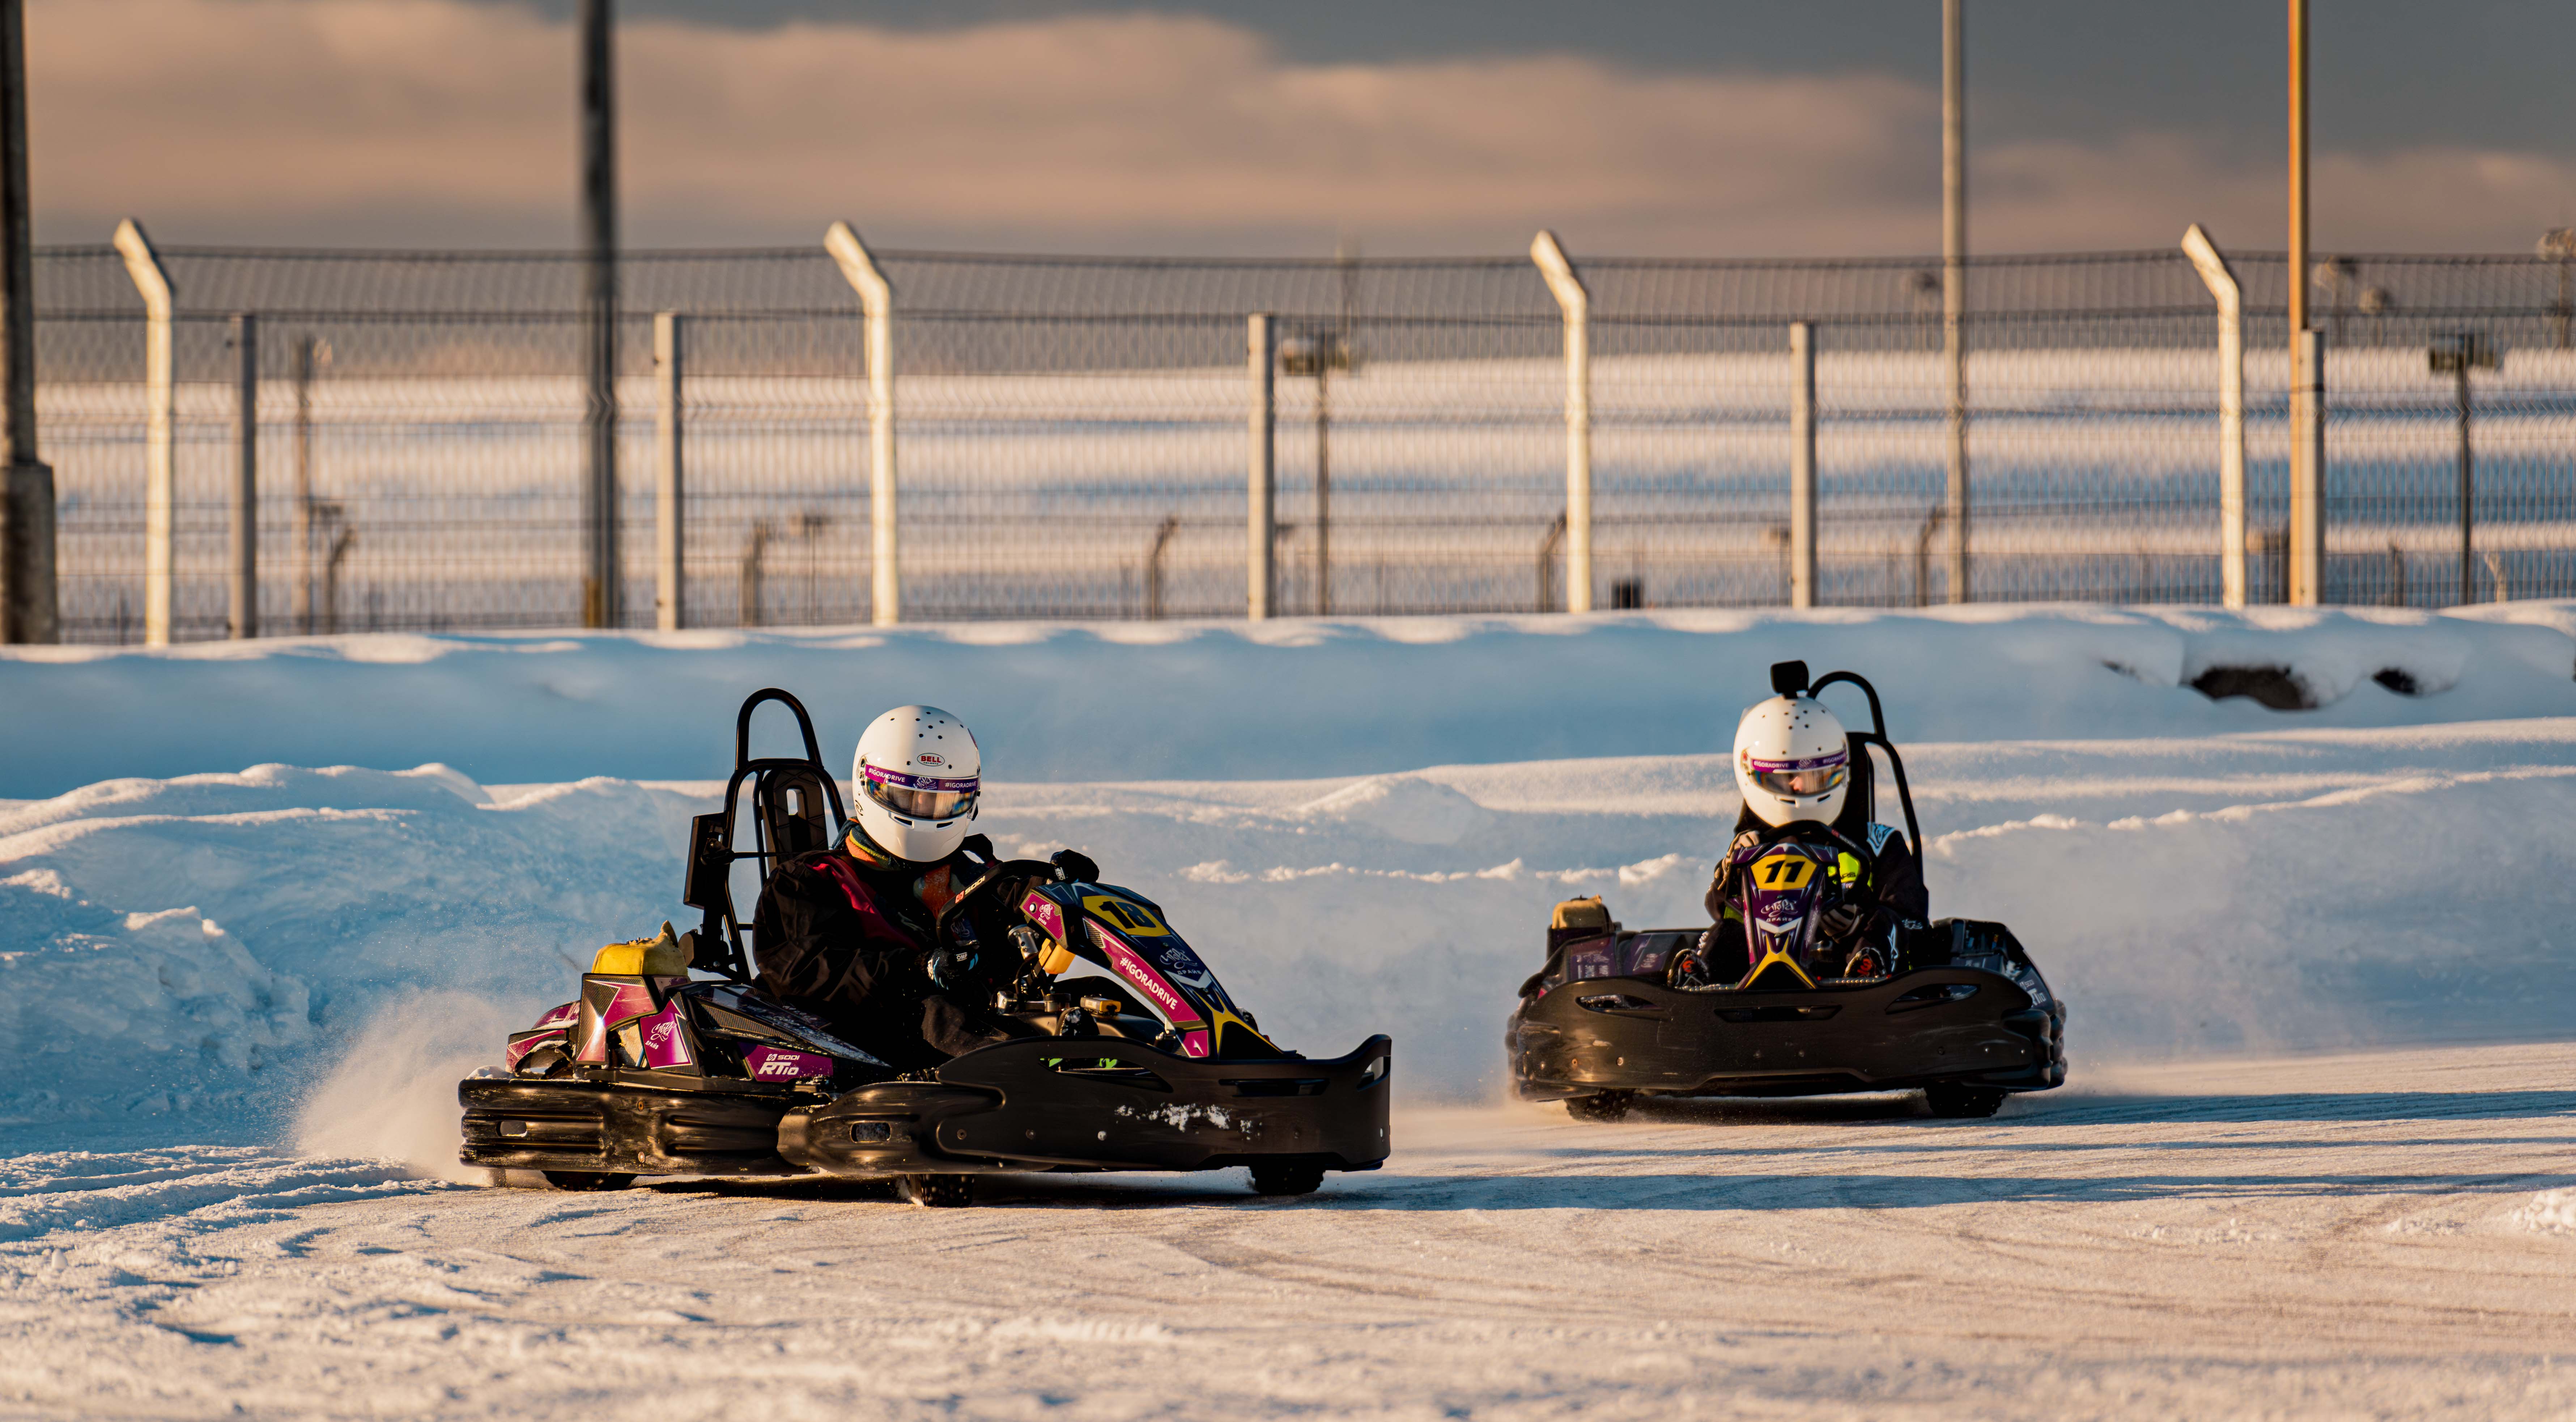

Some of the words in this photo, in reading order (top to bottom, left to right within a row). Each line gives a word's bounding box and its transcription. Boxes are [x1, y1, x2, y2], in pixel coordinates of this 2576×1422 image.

[868, 767, 905, 782] #IGORADRIVE
[1764, 860, 1806, 884] 11
[965, 875, 986, 895] SODI
[1099, 901, 1157, 929] 18
[1120, 957, 1178, 1011] #IGORADRIVE
[645, 1040, 659, 1049] ДРАЙВ
[758, 1062, 799, 1075] RT10
